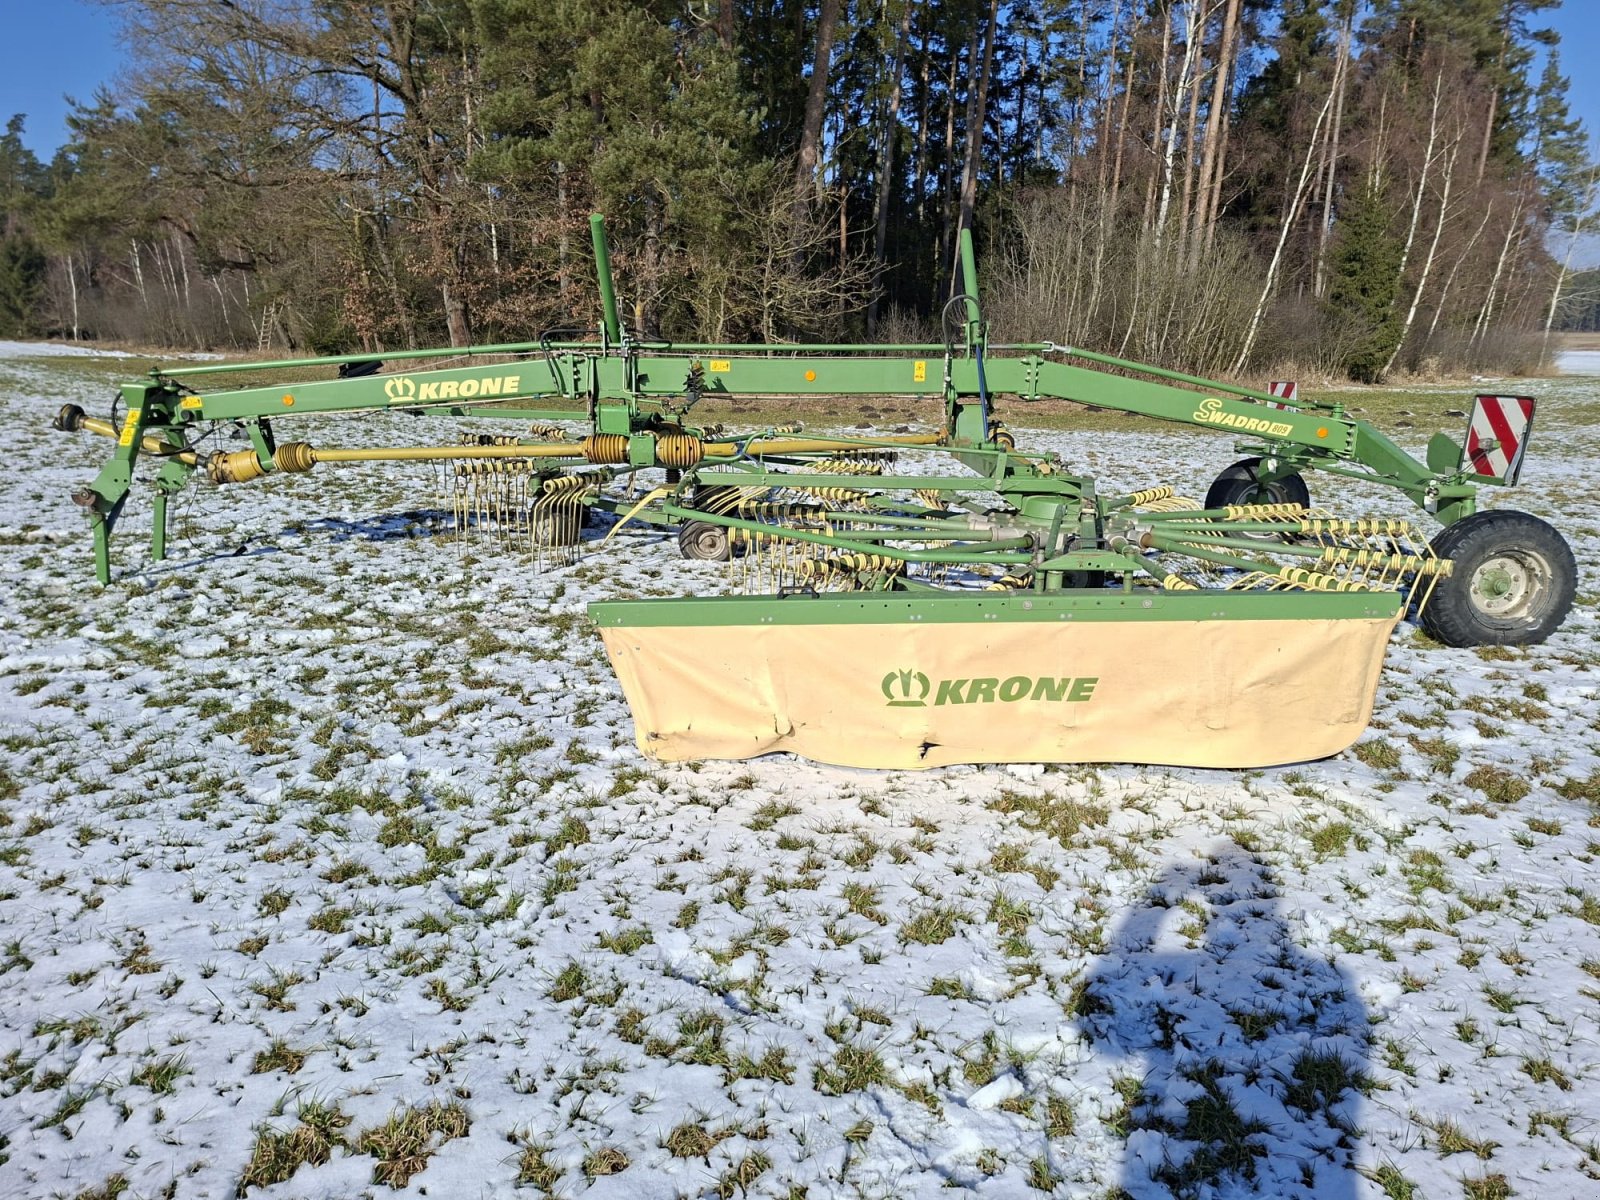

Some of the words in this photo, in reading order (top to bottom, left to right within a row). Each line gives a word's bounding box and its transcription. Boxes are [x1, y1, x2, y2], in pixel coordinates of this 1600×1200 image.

[418, 375, 521, 401] KRONE
[1193, 398, 1271, 432] SWADRO
[1271, 423, 1289, 435] 809
[934, 675, 1099, 706] KRONE
